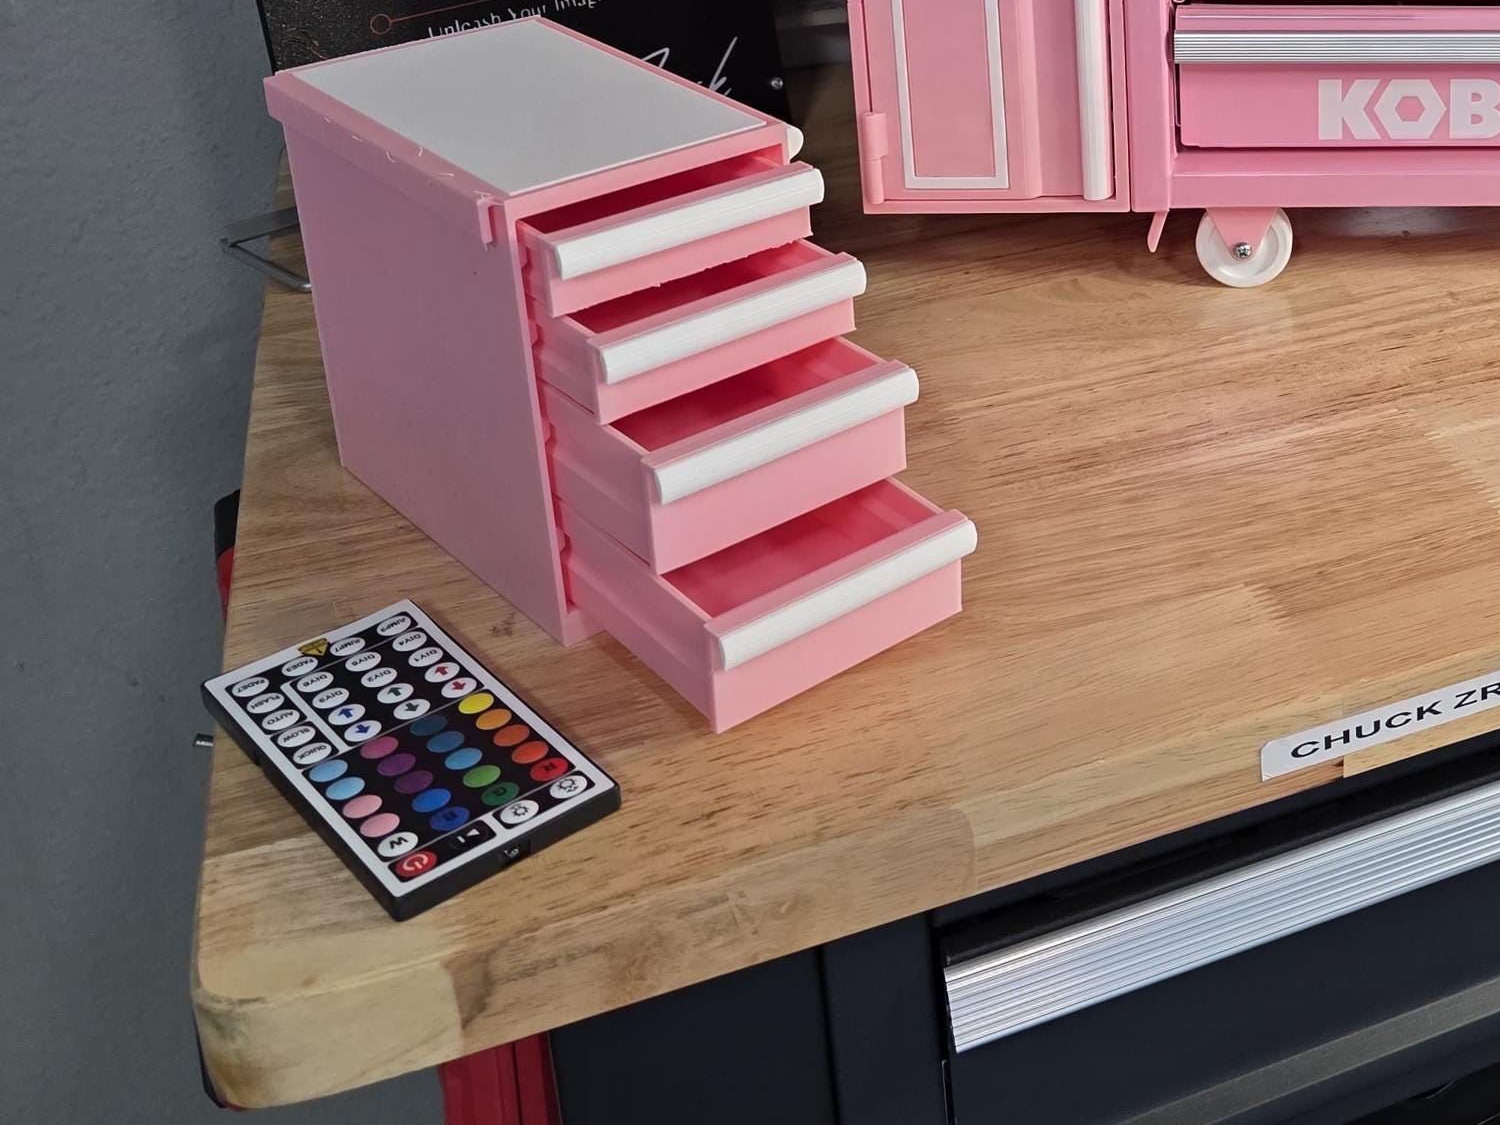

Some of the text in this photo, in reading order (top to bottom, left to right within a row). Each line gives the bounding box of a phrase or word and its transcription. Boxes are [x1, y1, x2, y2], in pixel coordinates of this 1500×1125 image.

[250, 694, 281, 710] FLASH
[267, 710, 294, 726] AUTO
[283, 727, 311, 744] SLOW
[1291, 700, 1443, 759] CHUCK
[297, 744, 328, 761] QUICK
[388, 836, 408, 850] W
